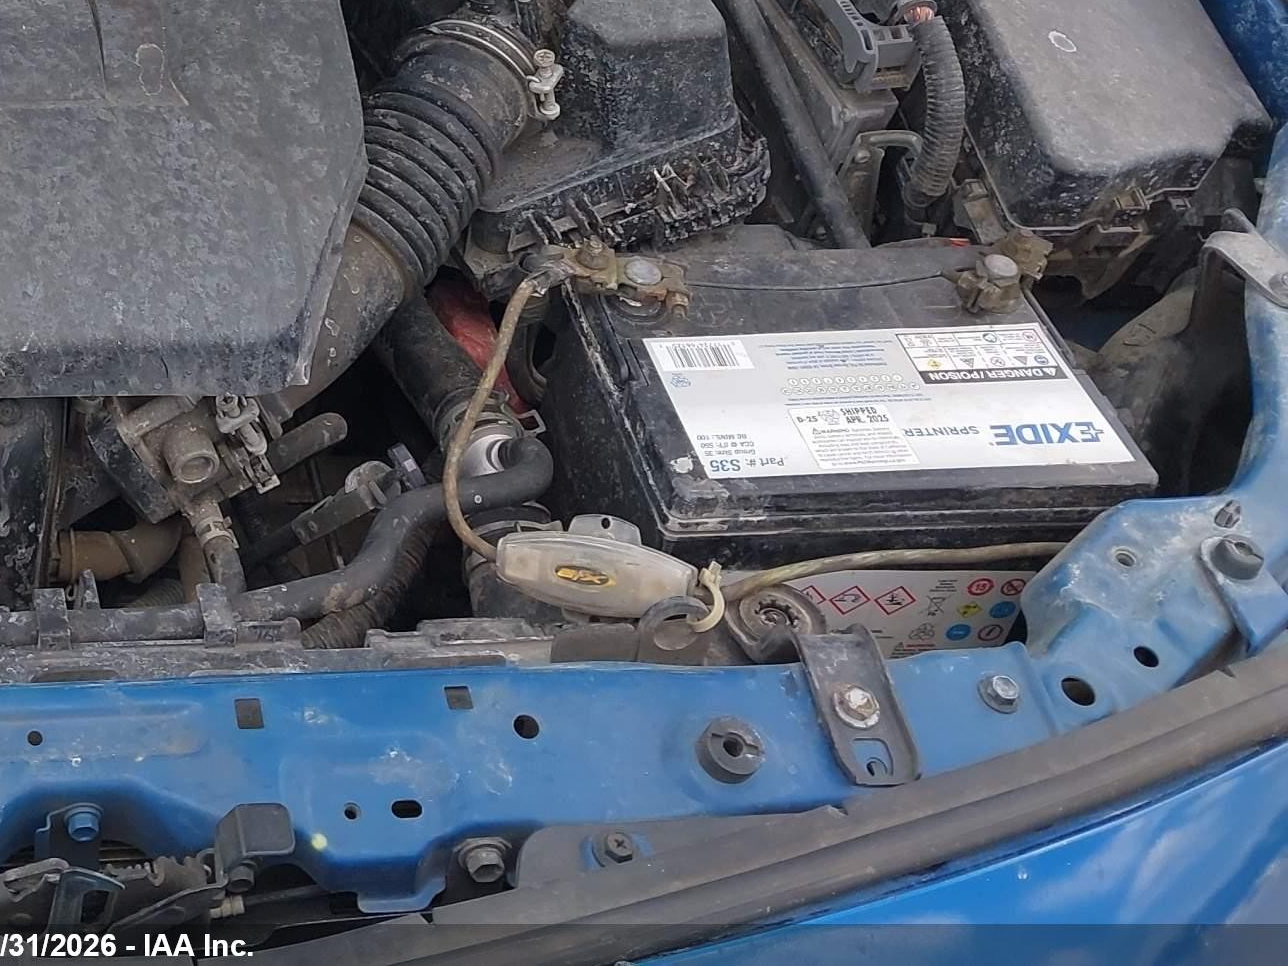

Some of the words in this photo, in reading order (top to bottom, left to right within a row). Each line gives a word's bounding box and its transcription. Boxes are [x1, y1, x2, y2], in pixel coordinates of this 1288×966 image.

[987, 367, 1043, 379] DANGER
[840, 406, 877, 416] SHIPPED
[869, 414, 890, 423] 2025
[903, 425, 980, 437] SPRINTER
[990, 421, 1104, 446] EXIDE
[734, 448, 756, 456] Group
[710, 459, 741, 472] S35
[759, 457, 785, 467] Part
